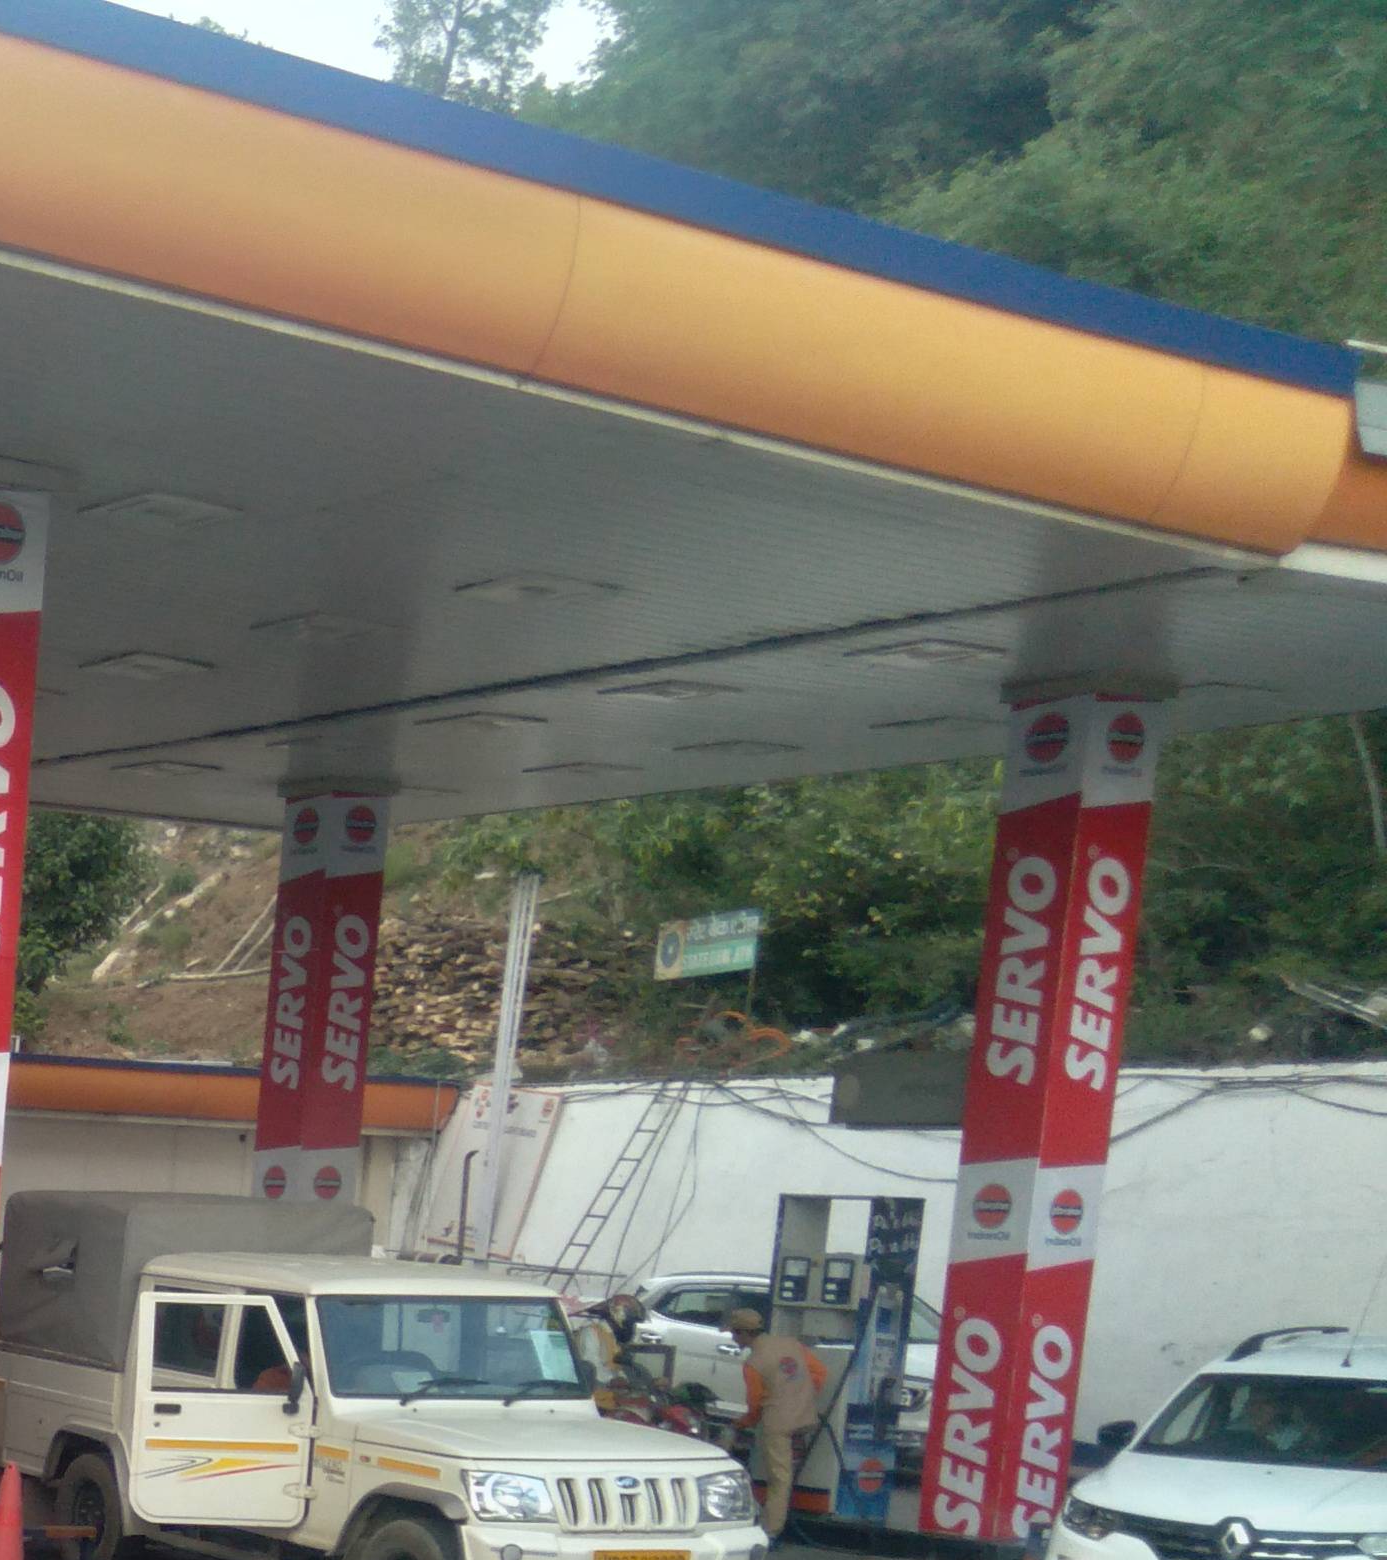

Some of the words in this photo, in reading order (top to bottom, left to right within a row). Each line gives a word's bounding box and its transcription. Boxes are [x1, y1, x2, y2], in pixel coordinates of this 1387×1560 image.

[270, 915, 311, 1090] SERVO
[321, 914, 371, 1092] SERVO
[986, 855, 1057, 1086] SERVO
[1065, 856, 1131, 1091] SERVO
[934, 1315, 1001, 1537] SERVO
[1012, 1324, 1074, 1540] SERVO
